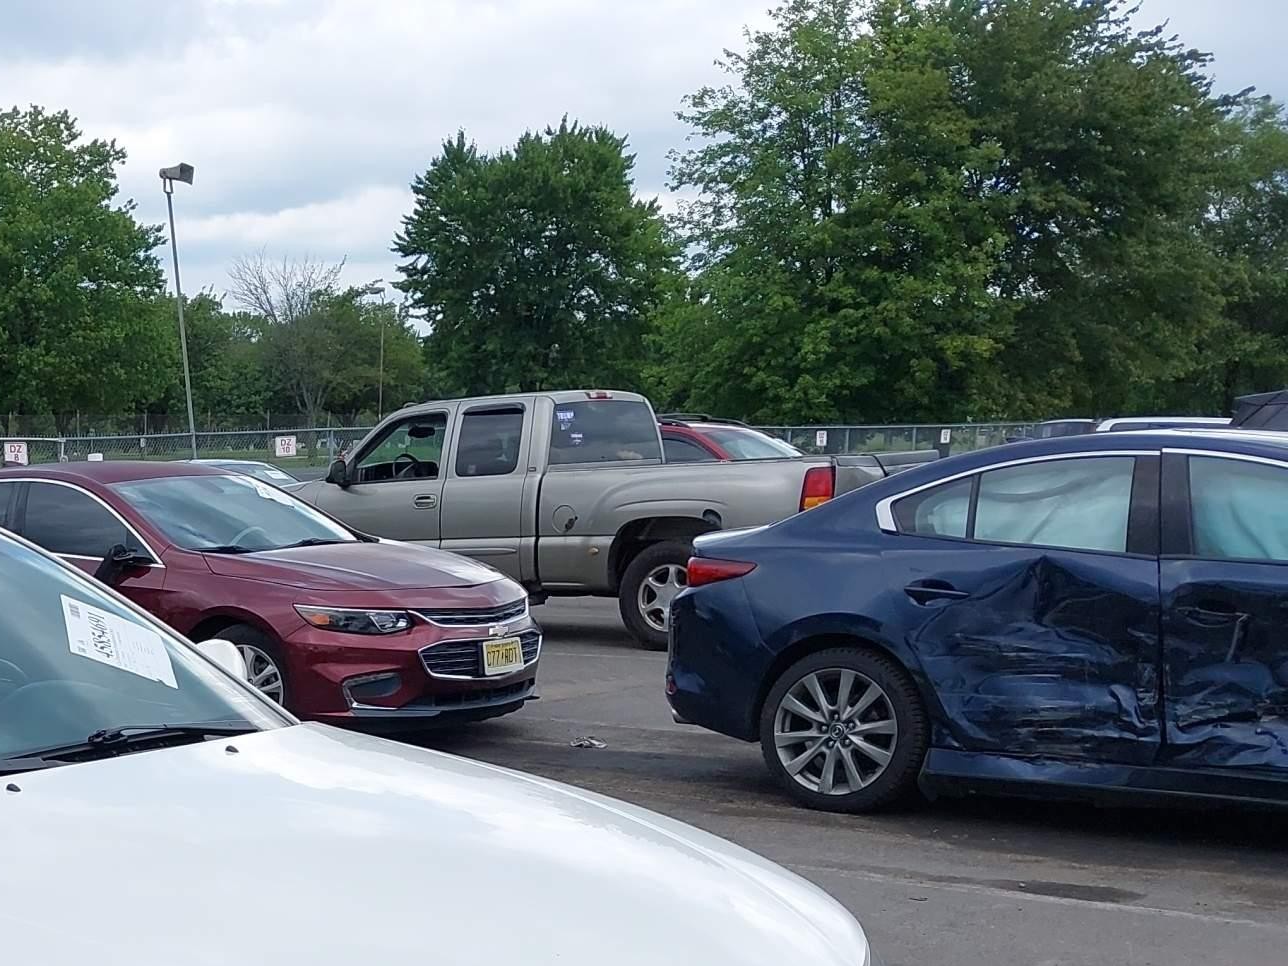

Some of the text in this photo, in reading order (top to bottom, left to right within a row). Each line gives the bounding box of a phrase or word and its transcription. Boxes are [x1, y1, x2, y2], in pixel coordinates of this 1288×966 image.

[281, 438, 292, 446] DZ
[9, 444, 22, 453] DZ
[14, 453, 19, 461] 8
[88, 611, 113, 658] 45854691
